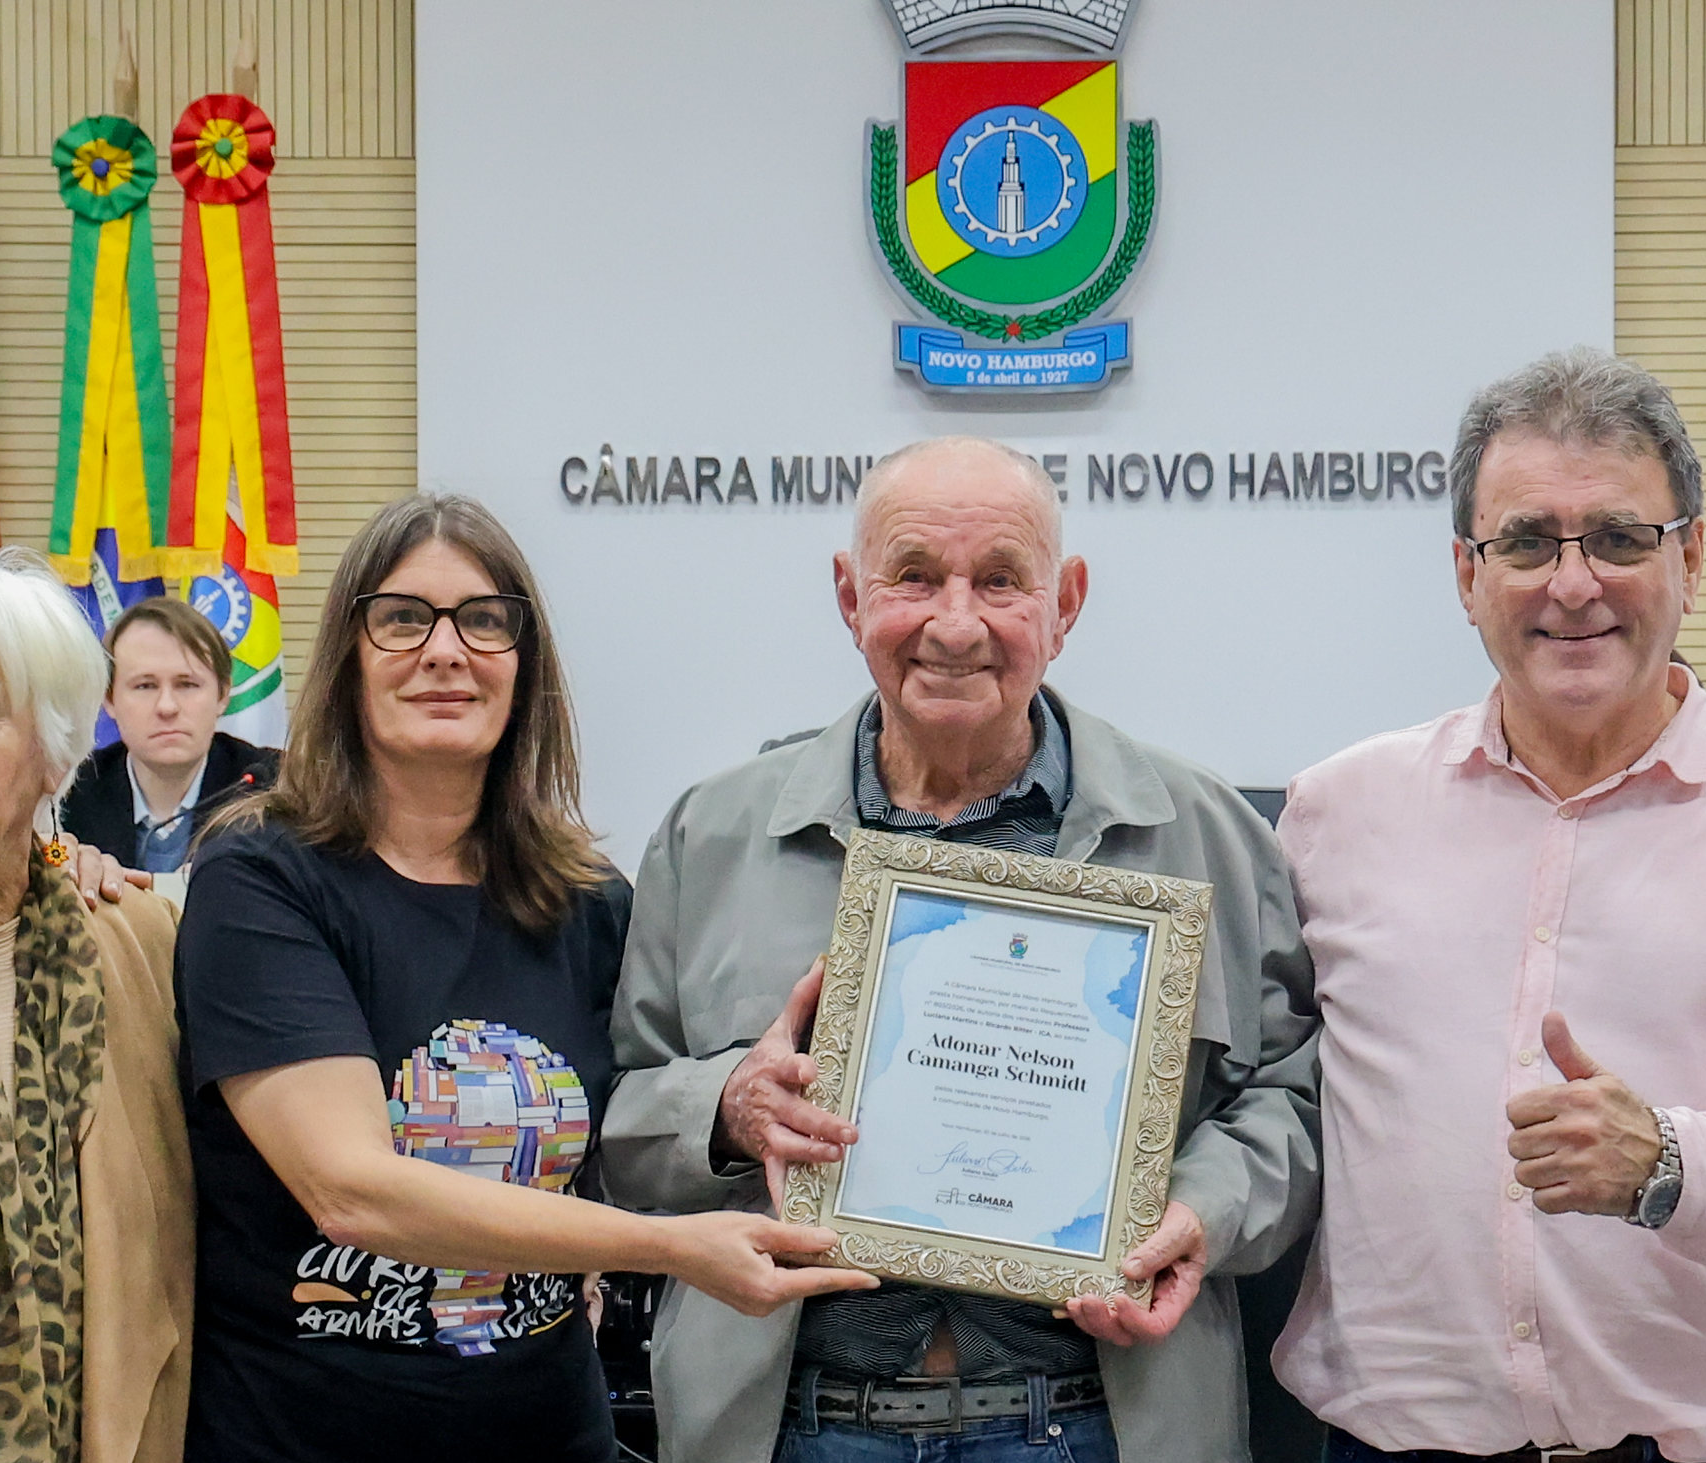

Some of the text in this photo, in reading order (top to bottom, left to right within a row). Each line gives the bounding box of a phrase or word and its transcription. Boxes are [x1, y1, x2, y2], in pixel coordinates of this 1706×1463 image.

[929, 351, 1097, 370] NOVO HAMBURGO
[966, 371, 1070, 384] 5 de abril de 1927
[560, 443, 758, 504] CÂMARA
[772, 455, 873, 504] MUN
[1088, 452, 1214, 503] NOVO
[1229, 451, 1447, 502] HAMBURG
[924, 1011, 950, 1020] Luciana
[952, 1015, 978, 1024] Martins
[926, 1033, 1074, 1070] Adonar Nelson
[907, 1048, 1089, 1093] Camanga Schmidt
[968, 1192, 1013, 1208] CÂMARA
[296, 1300, 422, 1340] ARMAS
